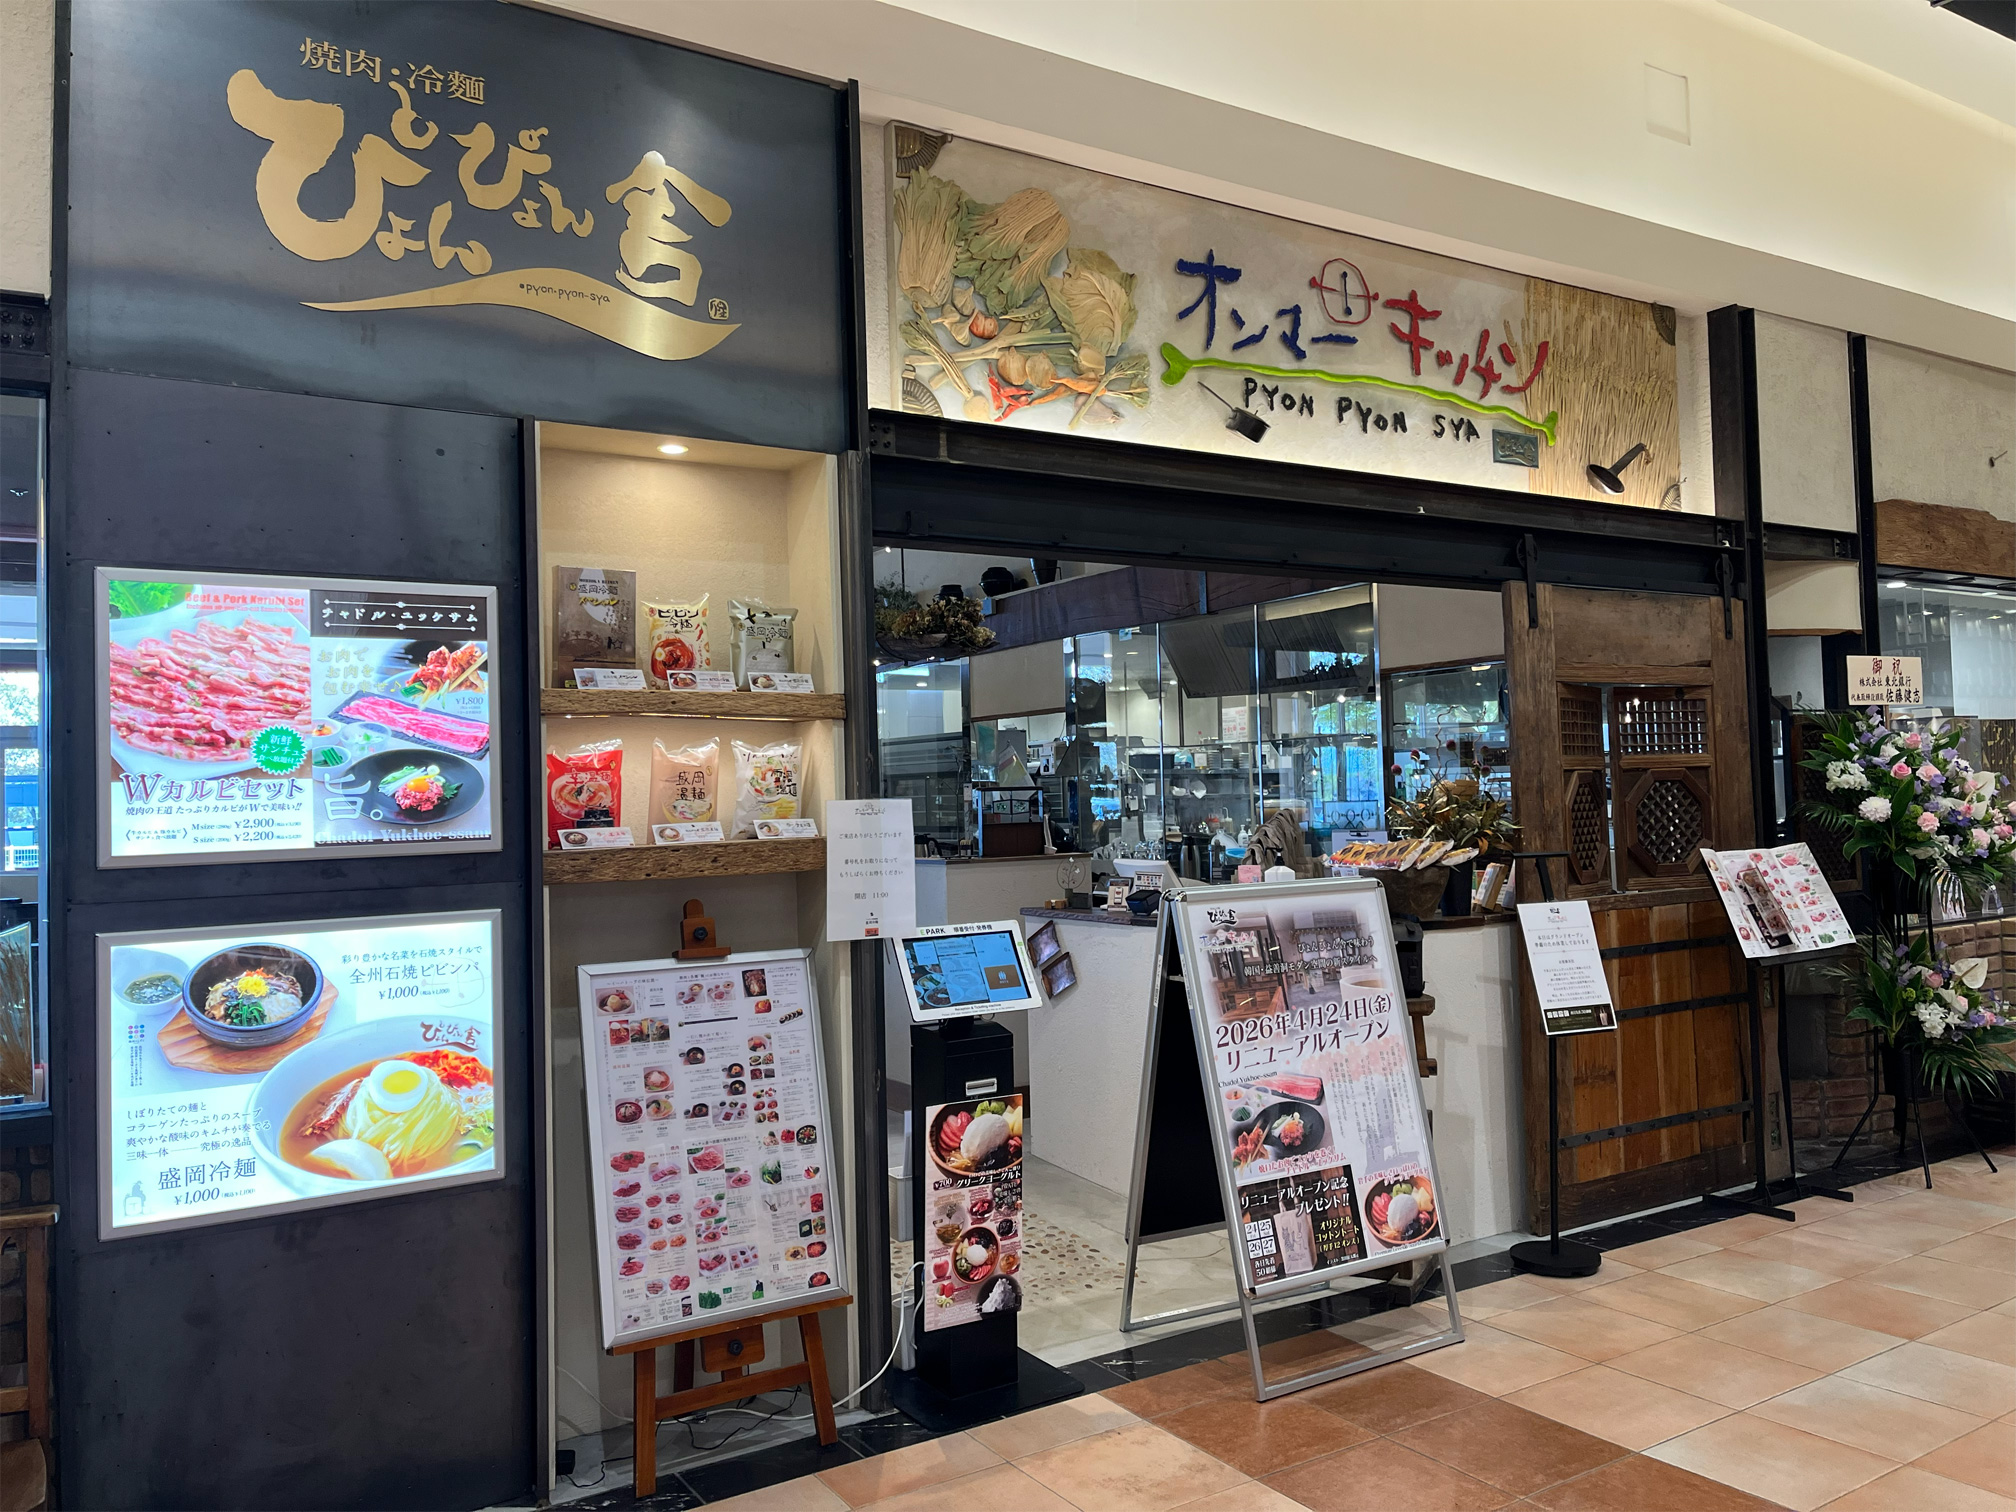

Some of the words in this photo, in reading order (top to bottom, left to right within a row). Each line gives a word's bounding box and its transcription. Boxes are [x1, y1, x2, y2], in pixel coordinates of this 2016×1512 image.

[1243, 377, 1315, 417] PYON
[1337, 396, 1408, 434] PYON
[1434, 414, 1481, 442] SYA
[185, 592, 210, 603] Beef
[213, 594, 220, 603] &
[223, 594, 247, 604] Pork
[287, 596, 304, 606] Set
[322, 608, 478, 622] チャドル・ユッケサム
[317, 647, 369, 663] お肉で
[326, 665, 374, 679] お肉を
[1859, 677, 1883, 687] 株式会社
[1885, 675, 1911, 687] 東北銀行
[1886, 688, 1920, 703] 佐藤健志
[270, 734, 292, 745] 新鮮
[260, 744, 300, 756] サンチュ
[119, 771, 305, 804] Wカルビセット
[125, 806, 173, 816] 焼肉の王道
[234, 818, 274, 829] ¥2,900
[234, 831, 274, 841] ¥2,200
[315, 830, 374, 845] Chadol
[380, 827, 491, 842] Yukhoe-ssam
[845, 857, 898, 865] 番号札をお取りになって
[839, 869, 904, 878] もうしばらくお待ちください
[1298, 936, 1375, 953] ぴょんぴょん舎で味わう
[341, 945, 482, 964] 彩り豊かな名菜を石焼スタイルで
[349, 962, 480, 984] 全州石焼ピビンパ
[379, 985, 419, 1000] ¥1,000
[1216, 994, 1392, 1048] 2026年4月24日(金)
[1227, 1019, 1390, 1073] リニューアルオープン
[127, 1102, 207, 1120] しぼりたての麺と
[126, 1108, 262, 1133] コラーゲンたっぷりのスープ
[126, 1120, 271, 1148] 爽やかな酸味のキムチが奏でる
[158, 1157, 257, 1190] 盛岡冷麺
[956, 1171, 1021, 1188] グリークヨーグルト
[174, 1187, 220, 1205] ¥1,000
[1240, 1177, 1349, 1209] リニューアルオープン記念
[1246, 1223, 1257, 1235] 24
[1260, 1220, 1271, 1231] 25
[1320, 1216, 1352, 1231] オリジナル
[1315, 1225, 1360, 1243] コットントート
[1250, 1241, 1260, 1252] 26
[1263, 1238, 1274, 1249] 27
